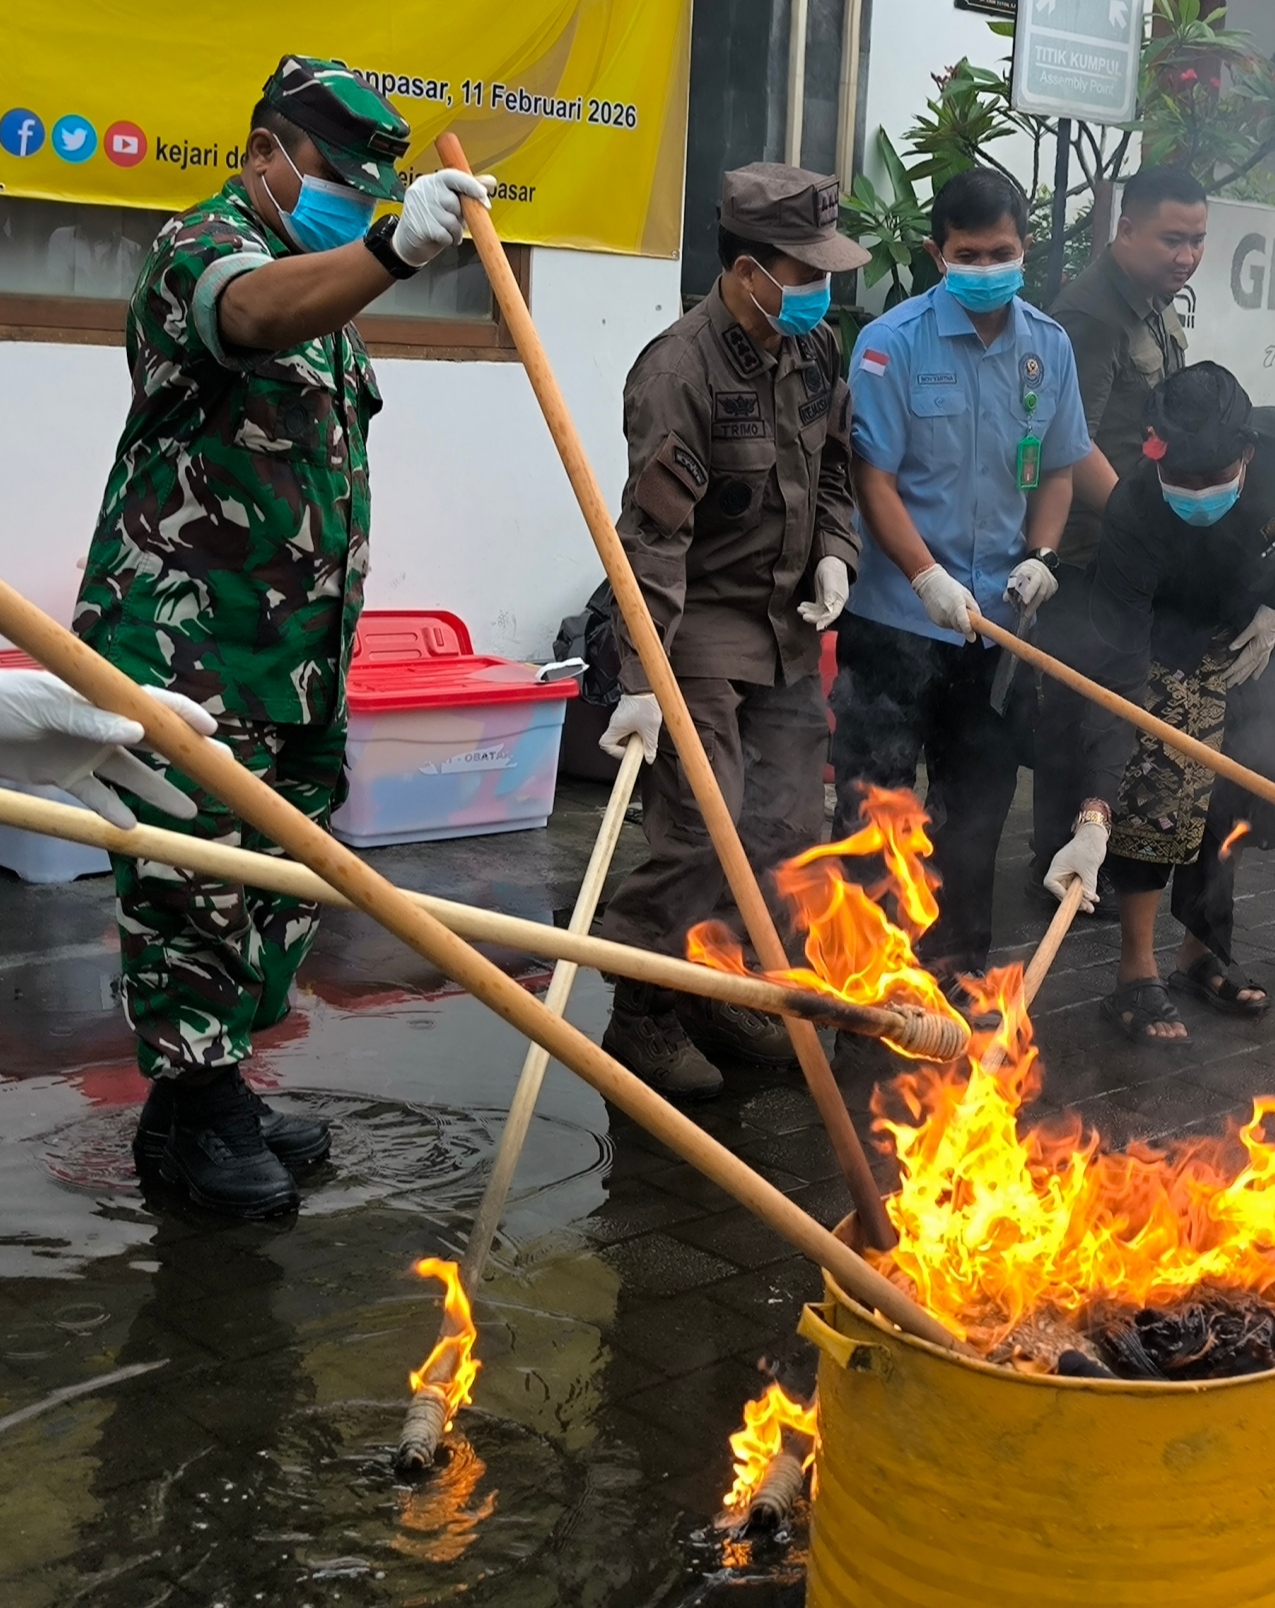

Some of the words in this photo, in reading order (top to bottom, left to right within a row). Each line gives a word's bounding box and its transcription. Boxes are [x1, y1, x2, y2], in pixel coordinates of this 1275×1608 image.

[1035, 45, 1067, 66] TITIK
[1070, 52, 1122, 76] KUMPUL
[331, 59, 453, 106] npasar,
[461, 80, 483, 105] 11
[491, 84, 582, 121] Februari
[588, 99, 637, 128] 2026
[1040, 70, 1088, 93] Assembly
[1090, 80, 1114, 96] Point
[156, 136, 218, 170] kejari
[721, 424, 759, 436] TRIMO
